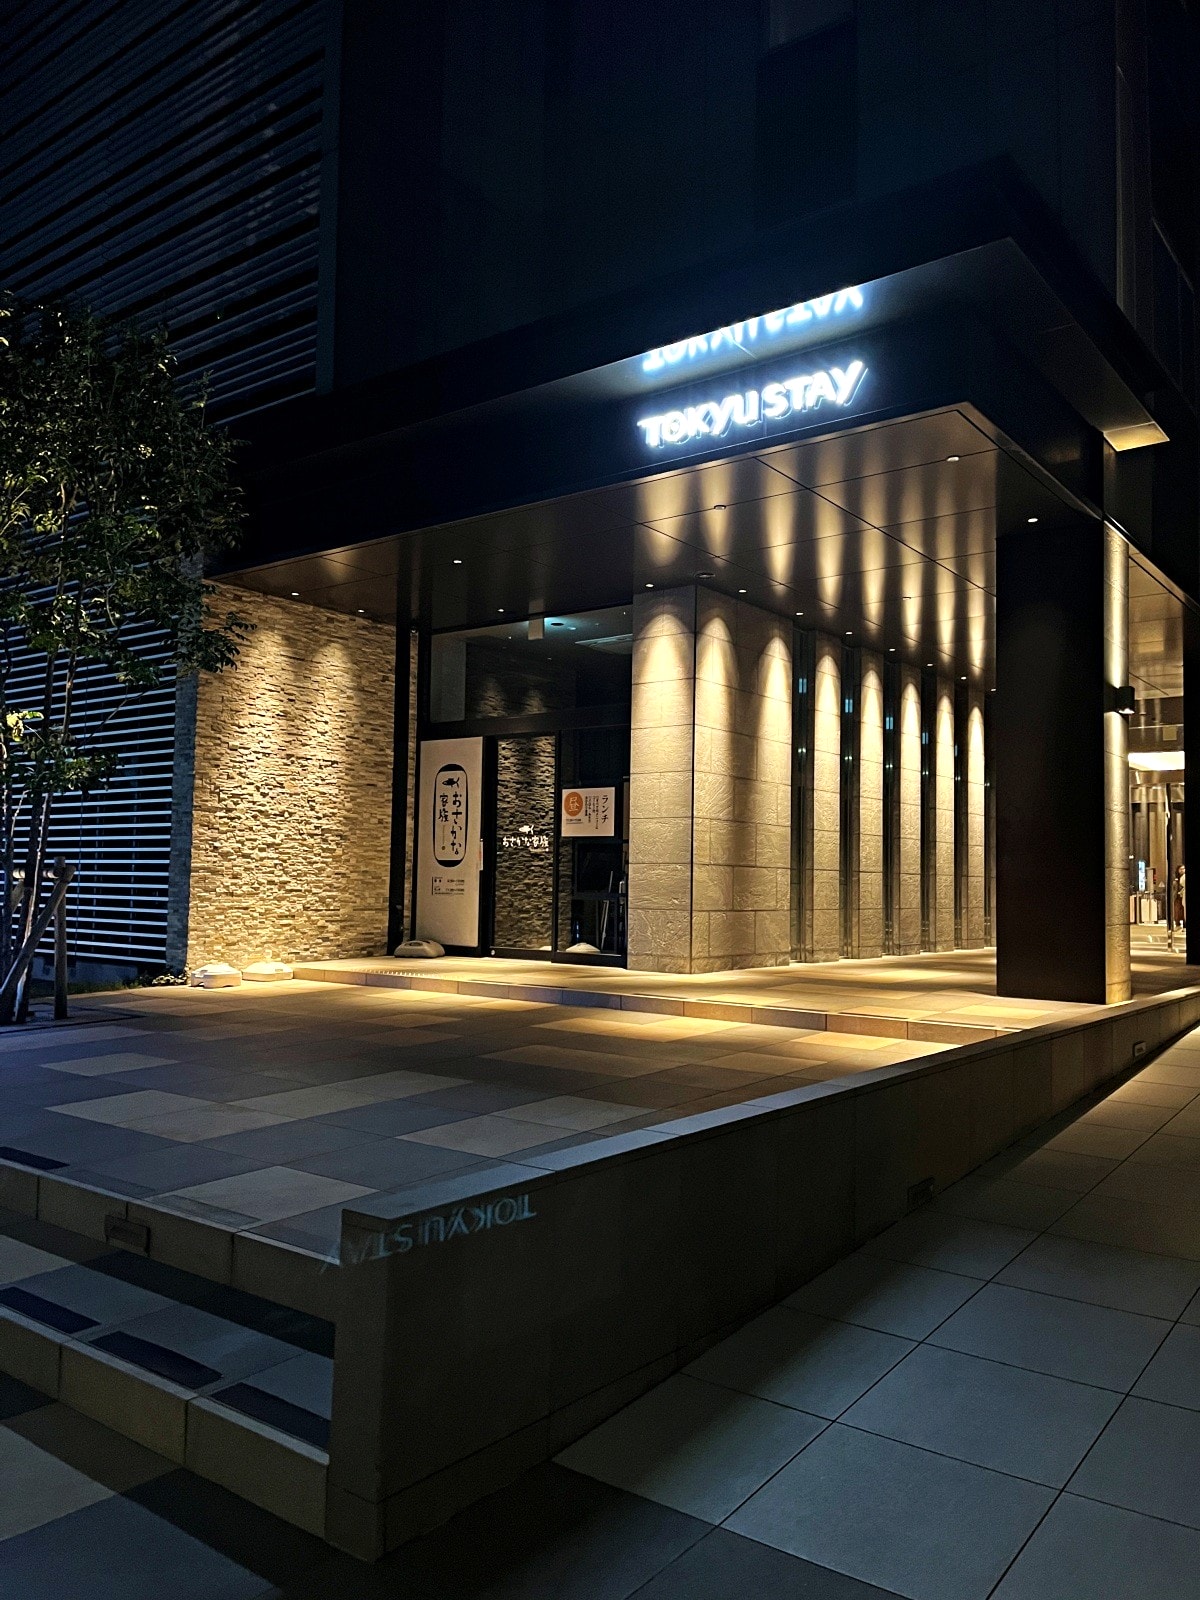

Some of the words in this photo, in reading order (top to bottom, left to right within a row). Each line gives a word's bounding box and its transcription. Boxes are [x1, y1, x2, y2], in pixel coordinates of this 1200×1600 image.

[637, 390, 762, 448] TOKYU
[763, 360, 868, 419] STAY
[438, 792, 449, 823] 家族
[601, 794, 609, 824] ランチ
[450, 791, 463, 856] おさかな
[502, 835, 549, 848] おさかな家族
